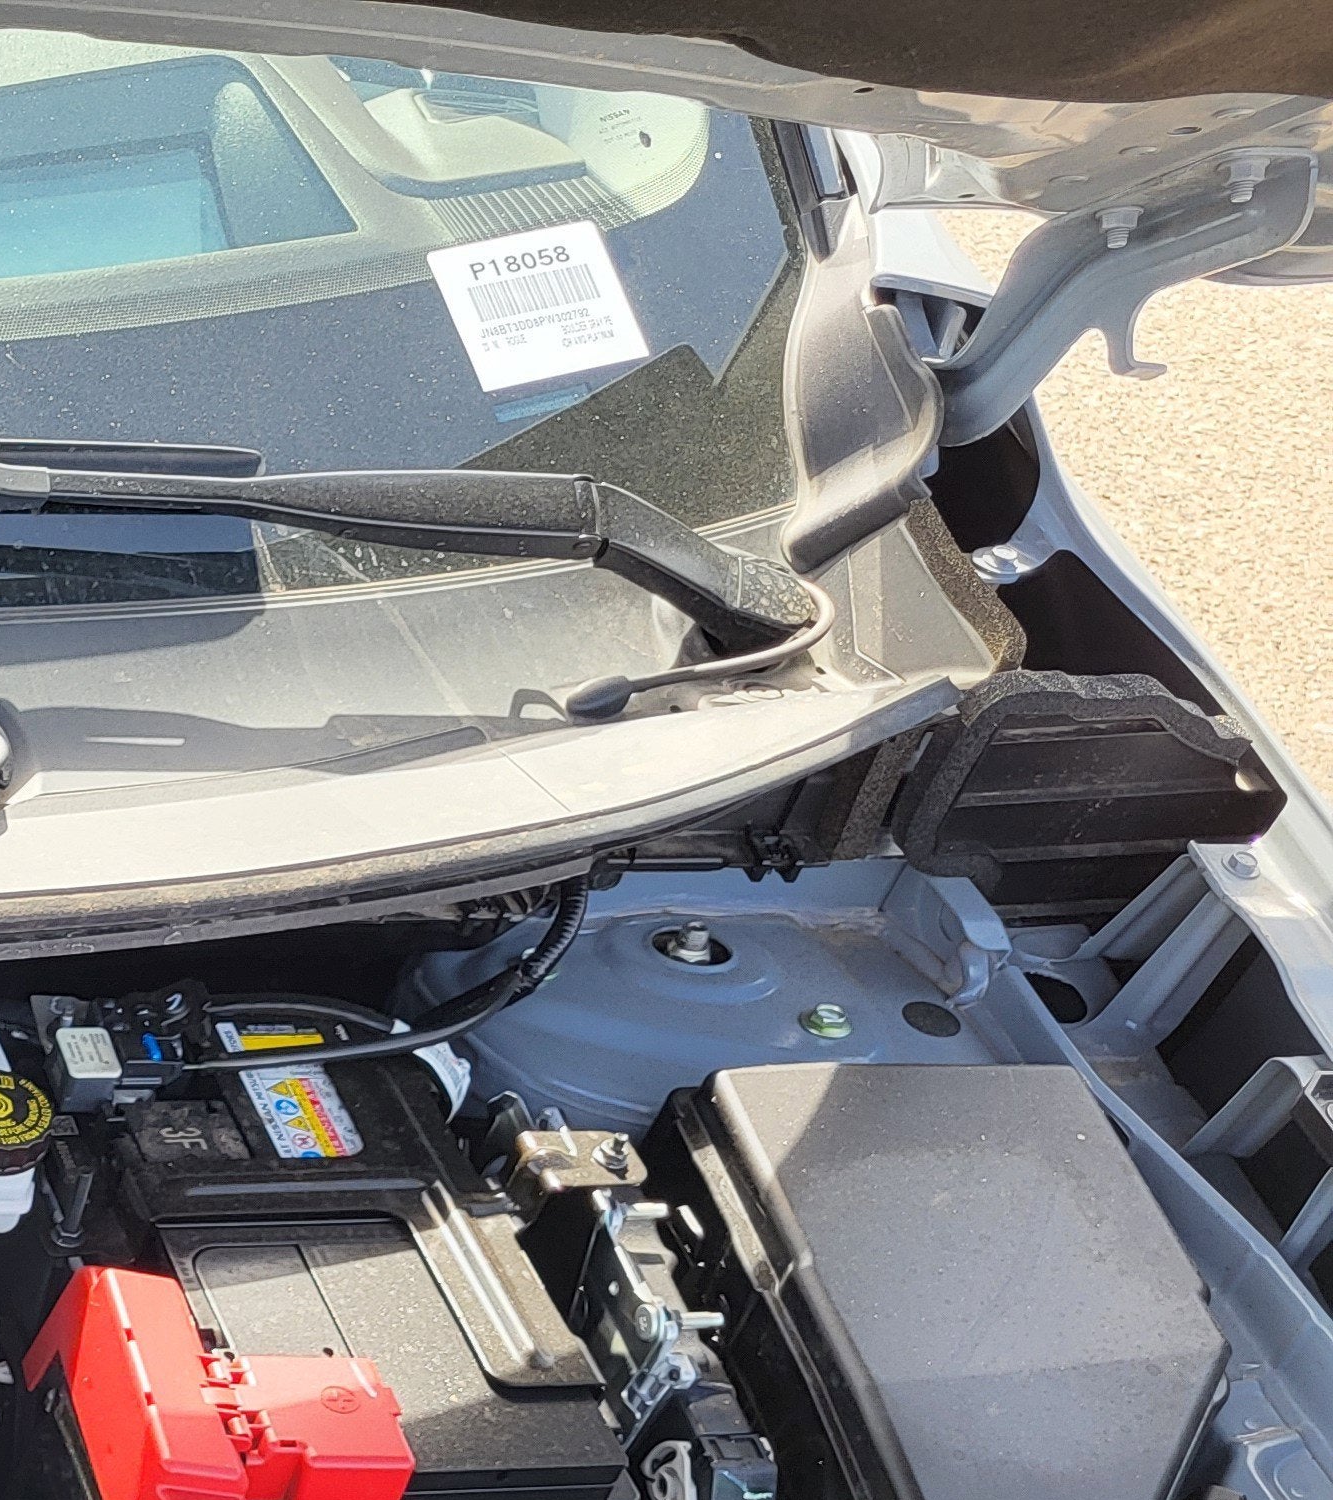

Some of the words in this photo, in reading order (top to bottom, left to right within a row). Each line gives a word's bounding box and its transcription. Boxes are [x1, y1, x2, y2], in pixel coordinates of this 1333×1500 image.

[599, 108, 630, 123] NISSAN
[469, 245, 570, 281] P18058
[159, 1126, 208, 1150] 3F
